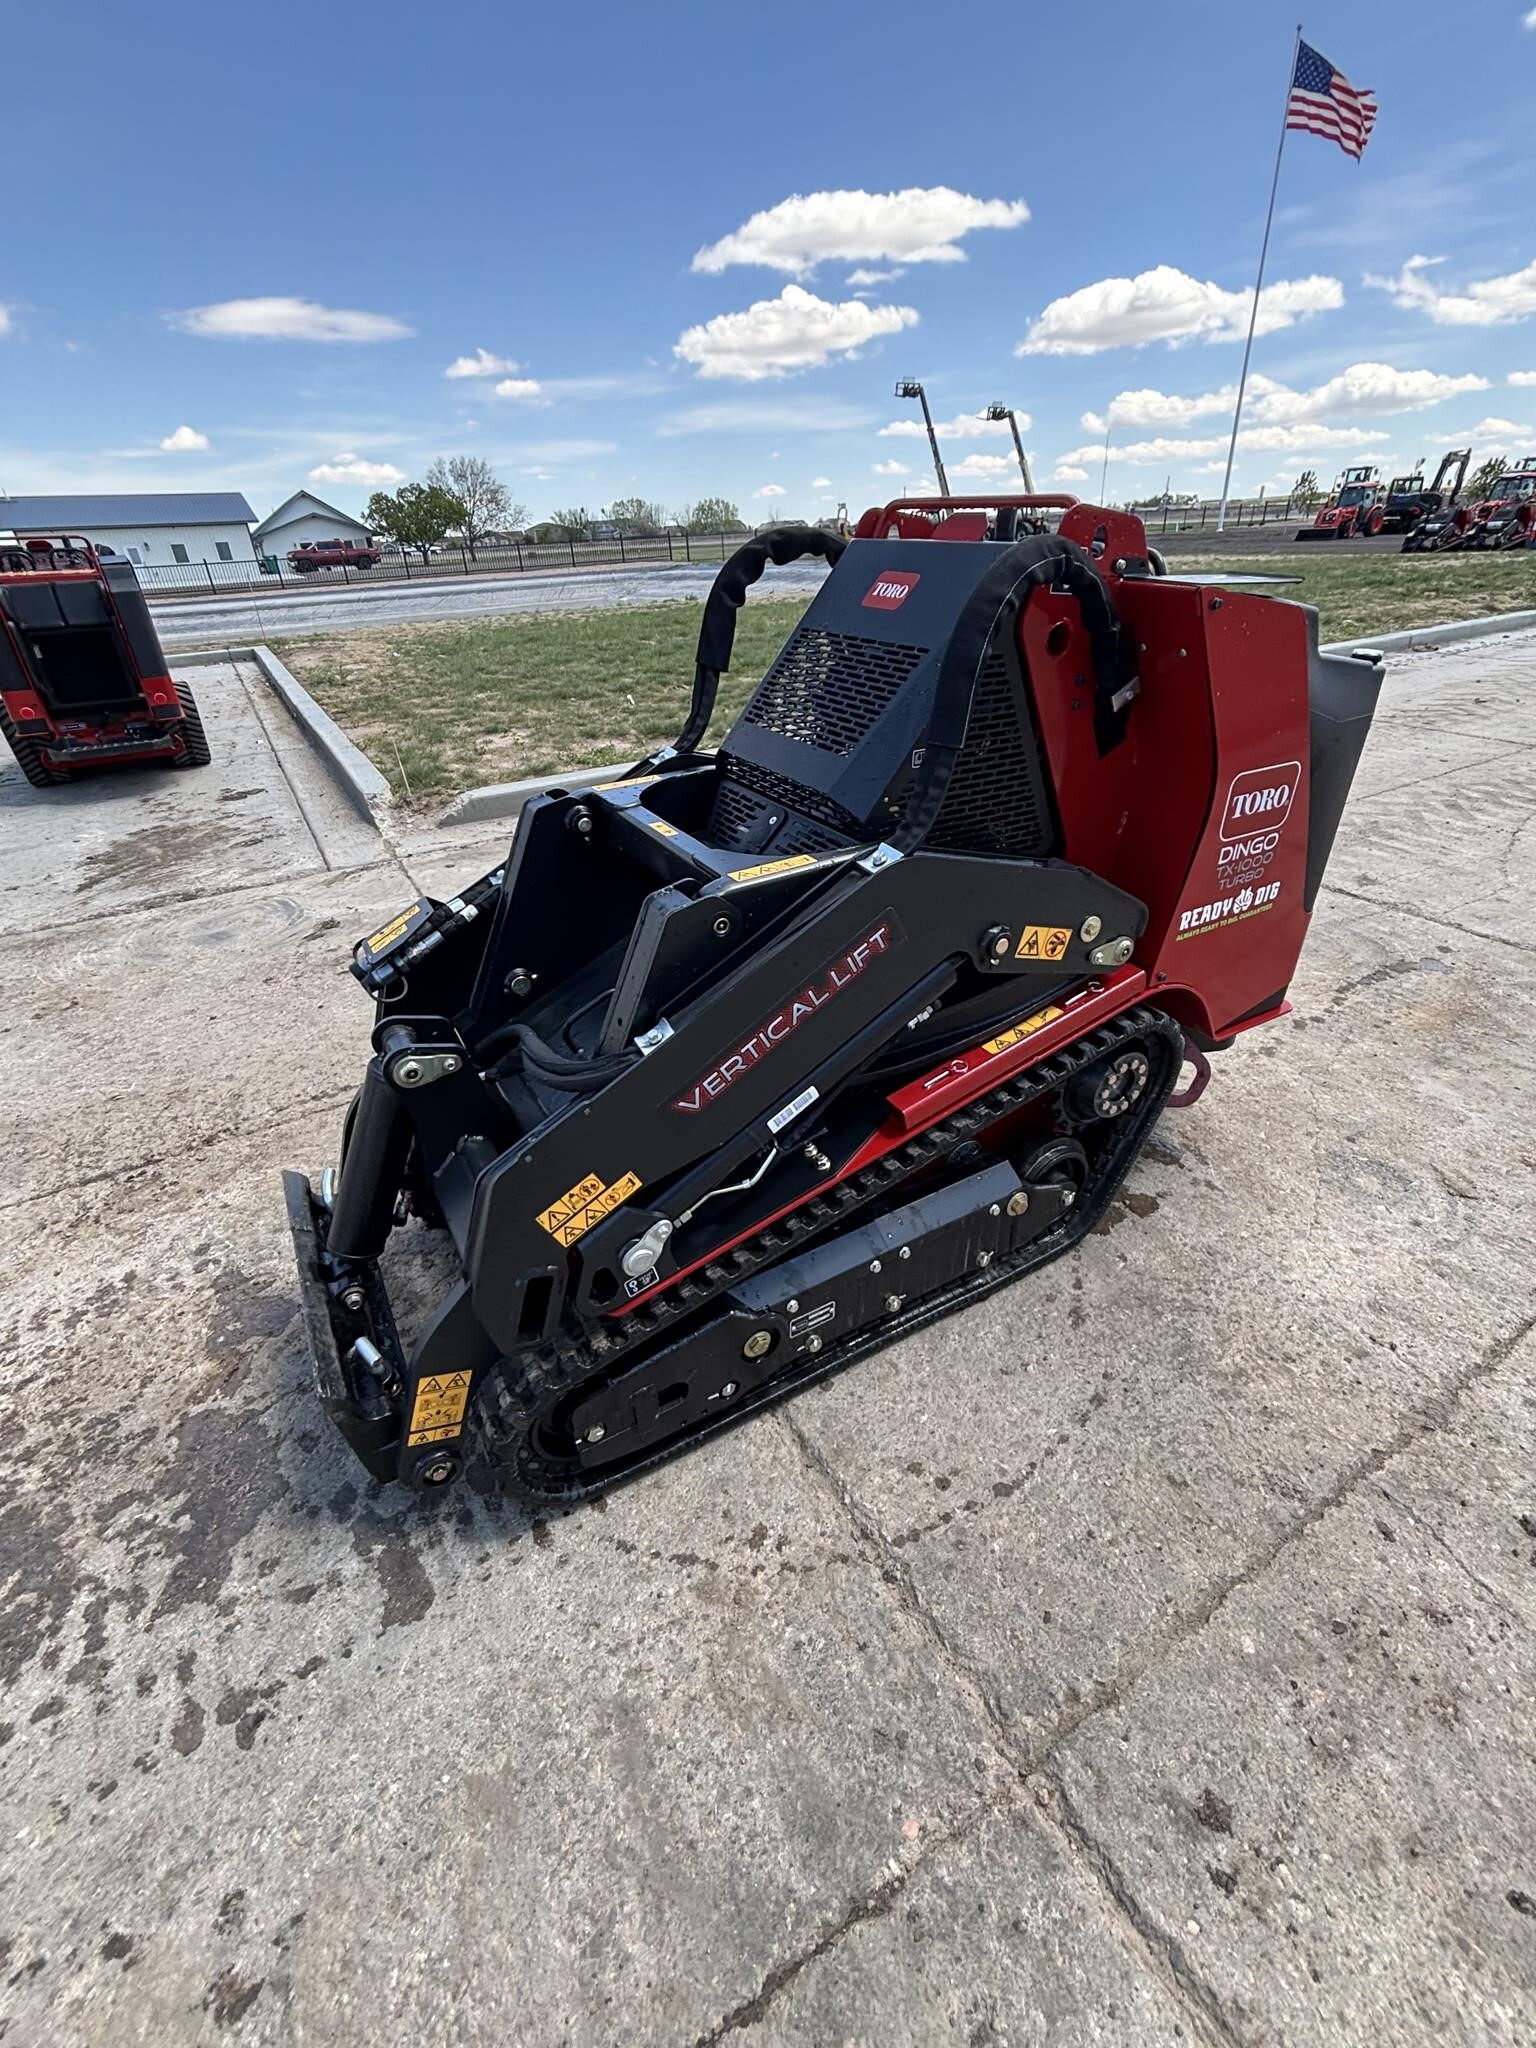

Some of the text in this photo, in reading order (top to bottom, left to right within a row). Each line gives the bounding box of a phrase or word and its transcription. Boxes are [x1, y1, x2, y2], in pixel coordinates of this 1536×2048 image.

[872, 582, 909, 599] TORO
[1231, 784, 1290, 819] TORO
[1218, 832, 1280, 865] DINGO
[1219, 867, 1265, 891] TURBO
[1179, 881, 1281, 931] READY DIG
[1176, 928, 1200, 942] ALWAYS
[1200, 922, 1220, 934] READY
[677, 927, 888, 1110] VERTICAL LIFT
